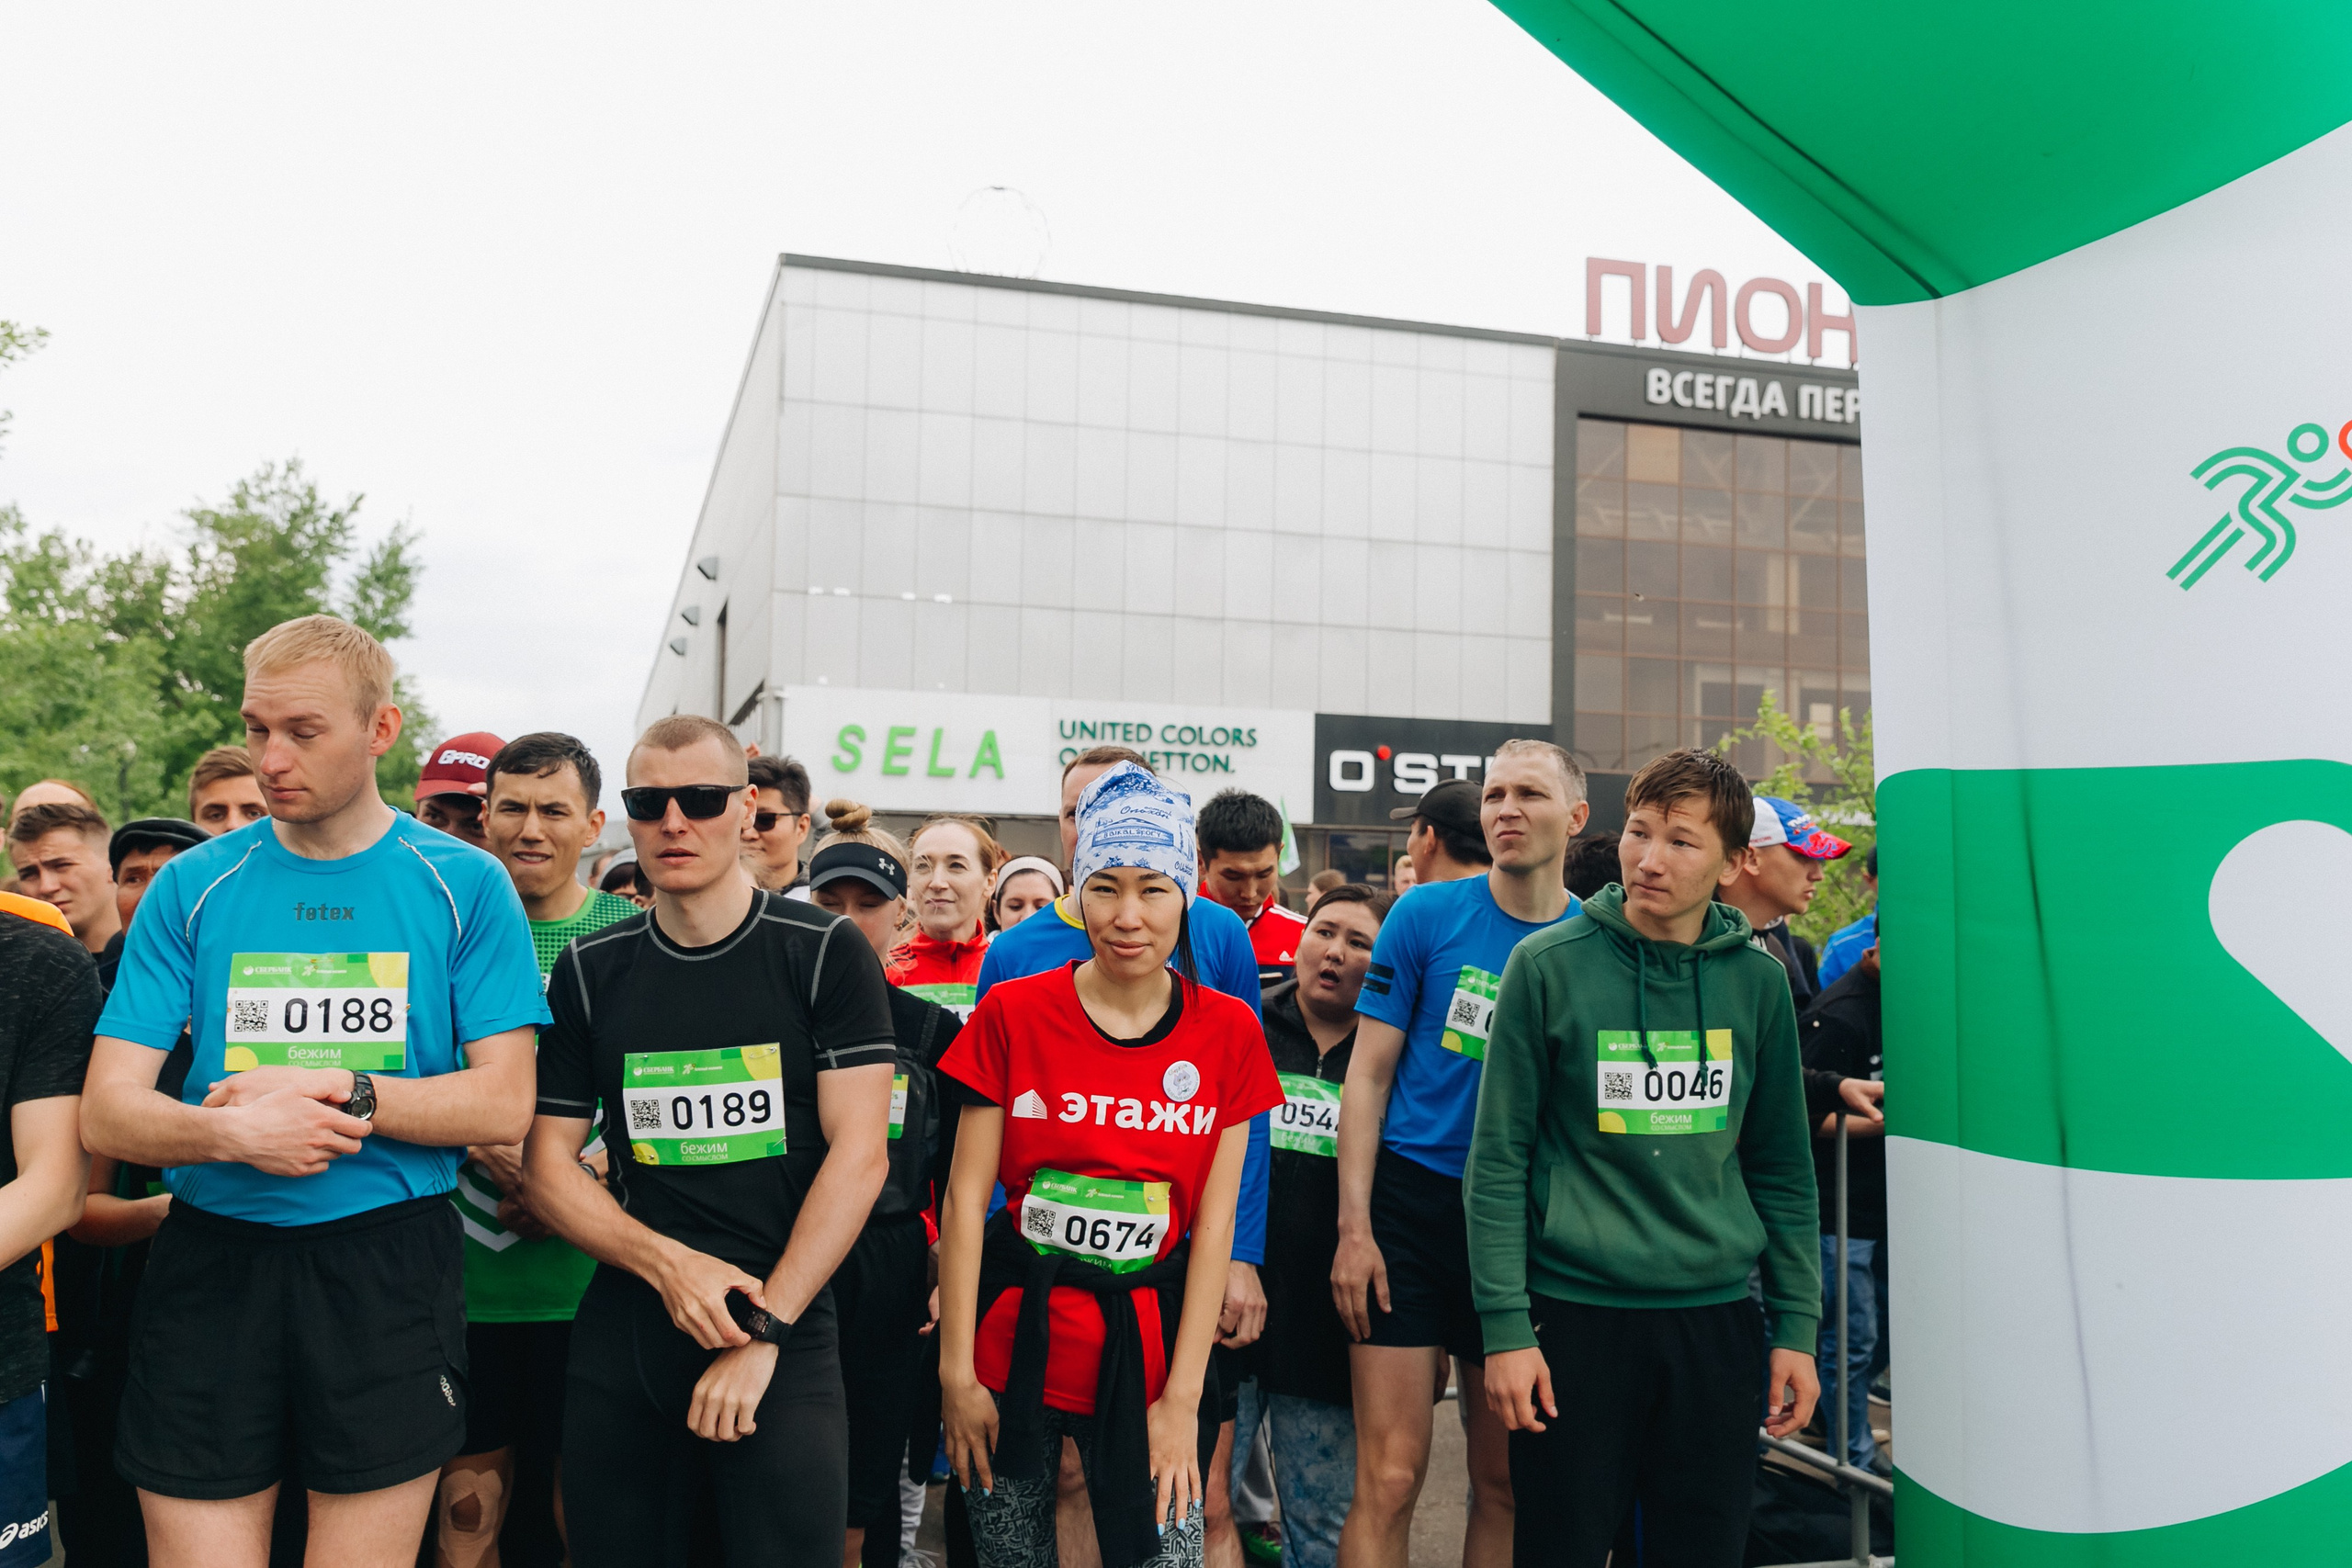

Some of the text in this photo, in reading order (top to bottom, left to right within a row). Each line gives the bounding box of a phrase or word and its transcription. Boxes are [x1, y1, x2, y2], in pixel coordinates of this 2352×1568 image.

[1586, 256, 1858, 365] ПИОН
[1645, 367, 1860, 423] ВСЕГДА ПЕР
[1059, 720, 1257, 747] UNITED COLORS
[831, 724, 1005, 779] SELA
[1141, 750, 1236, 773] ETTON.
[284, 998, 393, 1033] 0188
[288, 1046, 342, 1059] бежим
[1644, 1068, 1724, 1102] 0046
[672, 1089, 771, 1130] 0189
[1058, 1091, 1217, 1135] этажи
[1281, 1102, 1339, 1132] 054
[1650, 1112, 1692, 1124] бежим
[680, 1142, 728, 1155] бежим
[1065, 1215, 1156, 1253] 0674
[18, 1510, 49, 1540] asics
